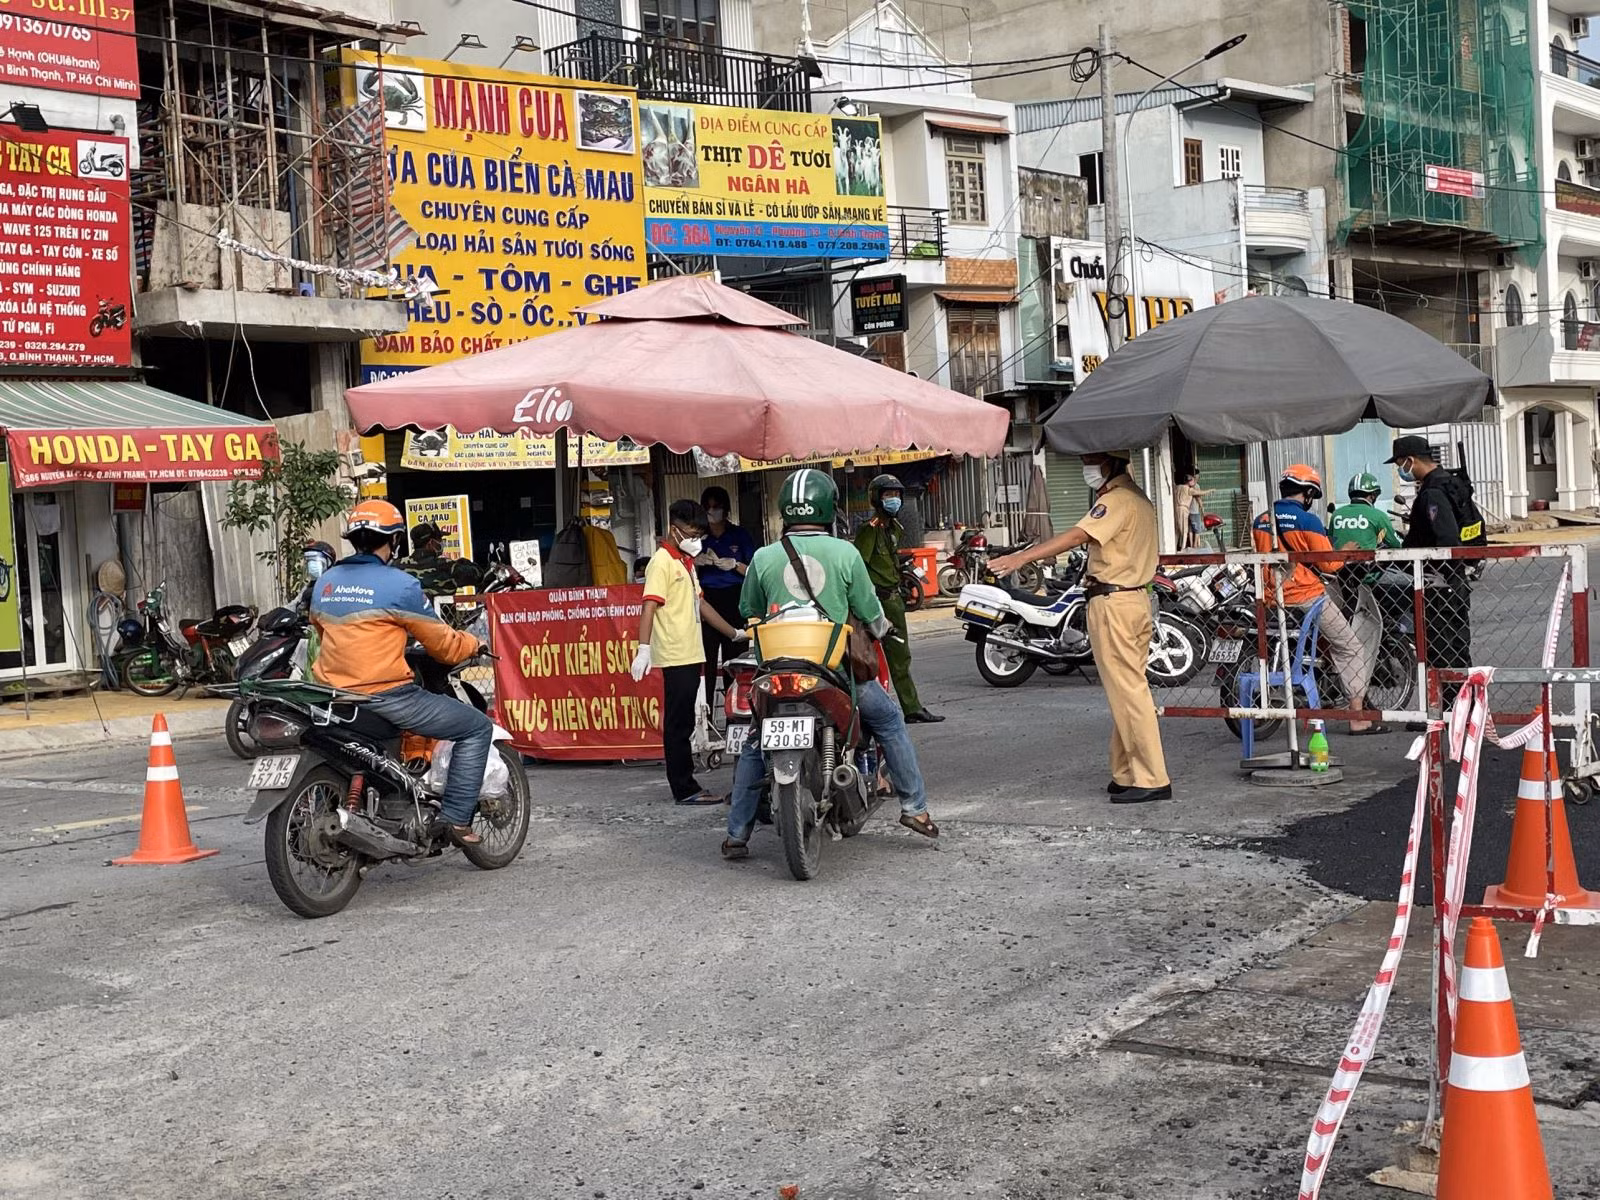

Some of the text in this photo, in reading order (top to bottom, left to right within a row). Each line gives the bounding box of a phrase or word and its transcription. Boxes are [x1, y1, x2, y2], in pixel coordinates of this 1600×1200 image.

[113, 79, 136, 91] Minh
[432, 77, 570, 143] MẠNH CUA
[701, 114, 828, 139] ĐỊA ĐIỂM CUNG CẤP
[6, 142, 72, 176] TAY GA
[701, 139, 832, 171] THỊT DÊ TƯƠI
[485, 147, 540, 194] BIỂN
[548, 159, 576, 197] CÀ
[586, 168, 634, 202] MAU
[727, 174, 810, 195] NGÂN HÀ
[59, 187, 85, 201] RUNG
[12, 202, 33, 216] MÁY
[36, 203, 55, 218] CÁC
[87, 209, 118, 223] HONDA
[421, 200, 589, 230] CHUYÊN CUNG CẤP
[3, 222, 108, 241] WAVE 125 TRÊN IC ZIN
[0, 242, 17, 255] TAY
[20, 244, 32, 256] GA
[42, 245, 60, 258] TAY
[63, 244, 82, 259] CÔN
[92, 249, 103, 260] XE
[416, 229, 634, 262] LOẠI HẢI SẢN TƯƠI SỐNG
[22, 261, 52, 276] CHÍNH
[478, 263, 551, 293] TÔM
[13, 282, 80, 297] SYM SUZUKI
[855, 292, 901, 309] TUYẾT MAI
[471, 296, 501, 326] SÒ
[18, 321, 43, 336] PGM,
[420, 329, 455, 353] BẢO
[80, 355, 114, 363] TP.HCM
[28, 433, 262, 465] HONDA TAY GA
[425, 503, 438, 511] CUA
[785, 505, 815, 516] Grab
[1333, 514, 1369, 530] Grab
[335, 585, 374, 595] AhaMove
[549, 593, 567, 603] QUẬN
[501, 613, 513, 624] BAN
[528, 612, 541, 625] ĐẠO
[520, 630, 560, 678] CHỐT
[565, 625, 602, 676] KIỂM
[504, 693, 548, 741] THỰC
[552, 690, 589, 741] HIỆN
[591, 684, 618, 731] CHỈ
